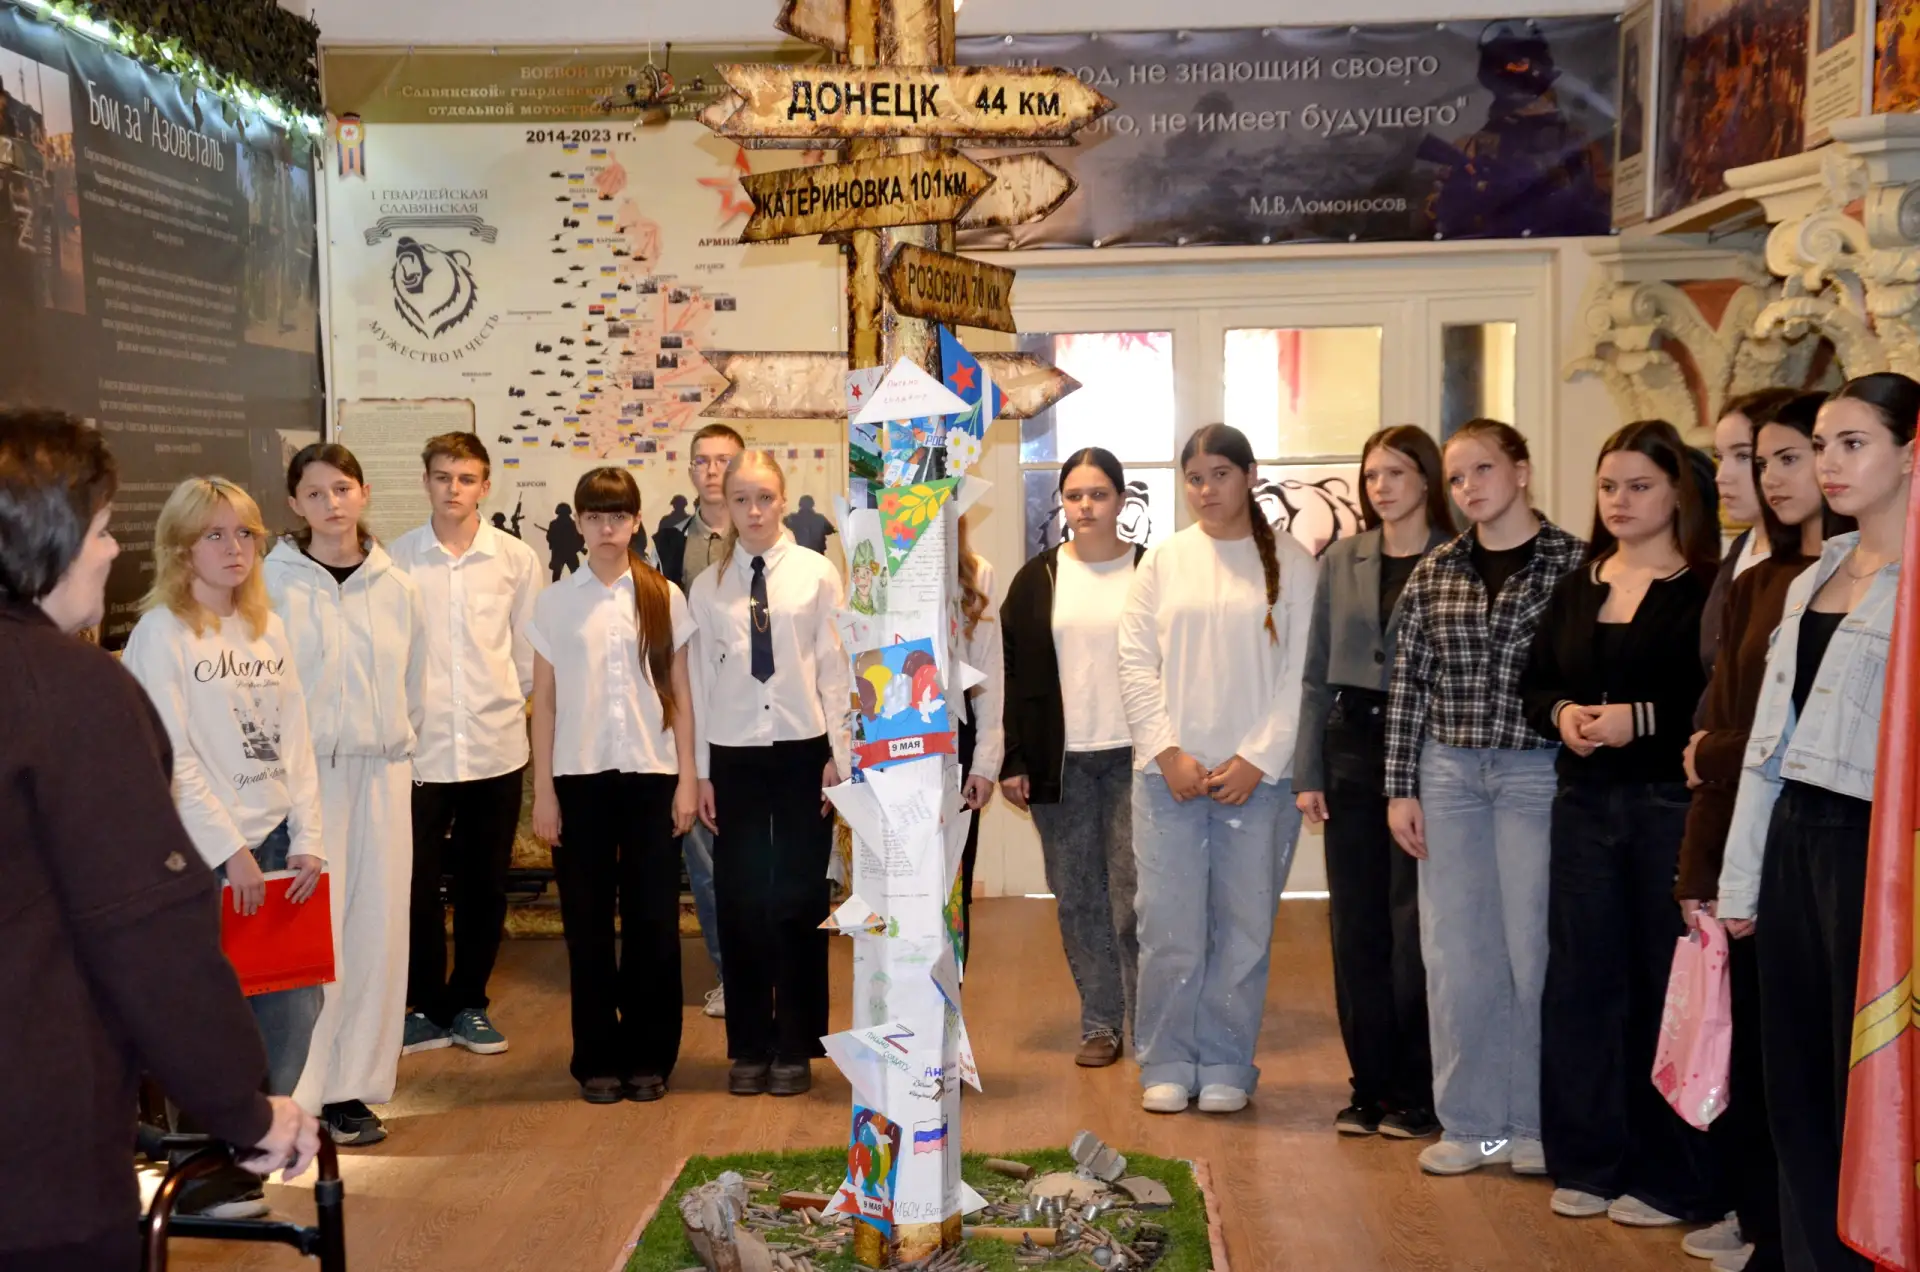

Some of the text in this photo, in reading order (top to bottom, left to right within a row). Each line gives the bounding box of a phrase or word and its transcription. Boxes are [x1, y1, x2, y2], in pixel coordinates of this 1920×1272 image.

[594, 64, 638, 79] ПУТЬ
[1130, 64, 1168, 85] не
[1177, 55, 1322, 83] знающий
[1331, 54, 1441, 80] своего
[428, 101, 515, 117] отдельной
[787, 80, 939, 124] ДОНЕЦК
[975, 86, 1008, 115] 44
[123, 104, 143, 143] за
[1151, 110, 1188, 133] не
[1198, 108, 1290, 133] имеет
[526, 129, 637, 144] 2014-2023 гг.
[382, 187, 488, 201] ГВАРДЕЙСКАЯ
[759, 174, 904, 219] КАТЕРИНОВКА
[379, 203, 479, 215] СЛАВЯНСКАЯ
[698, 237, 740, 247] АРМИЯ
[908, 262, 969, 308] РОЗОВКА
[971, 275, 985, 309] 70
[369, 313, 500, 364] МУЖЕСТВО И ЧЕСТЬ
[892, 740, 921, 752] 9 МАЯ
[869, 1202, 883, 1213] МАЯ
